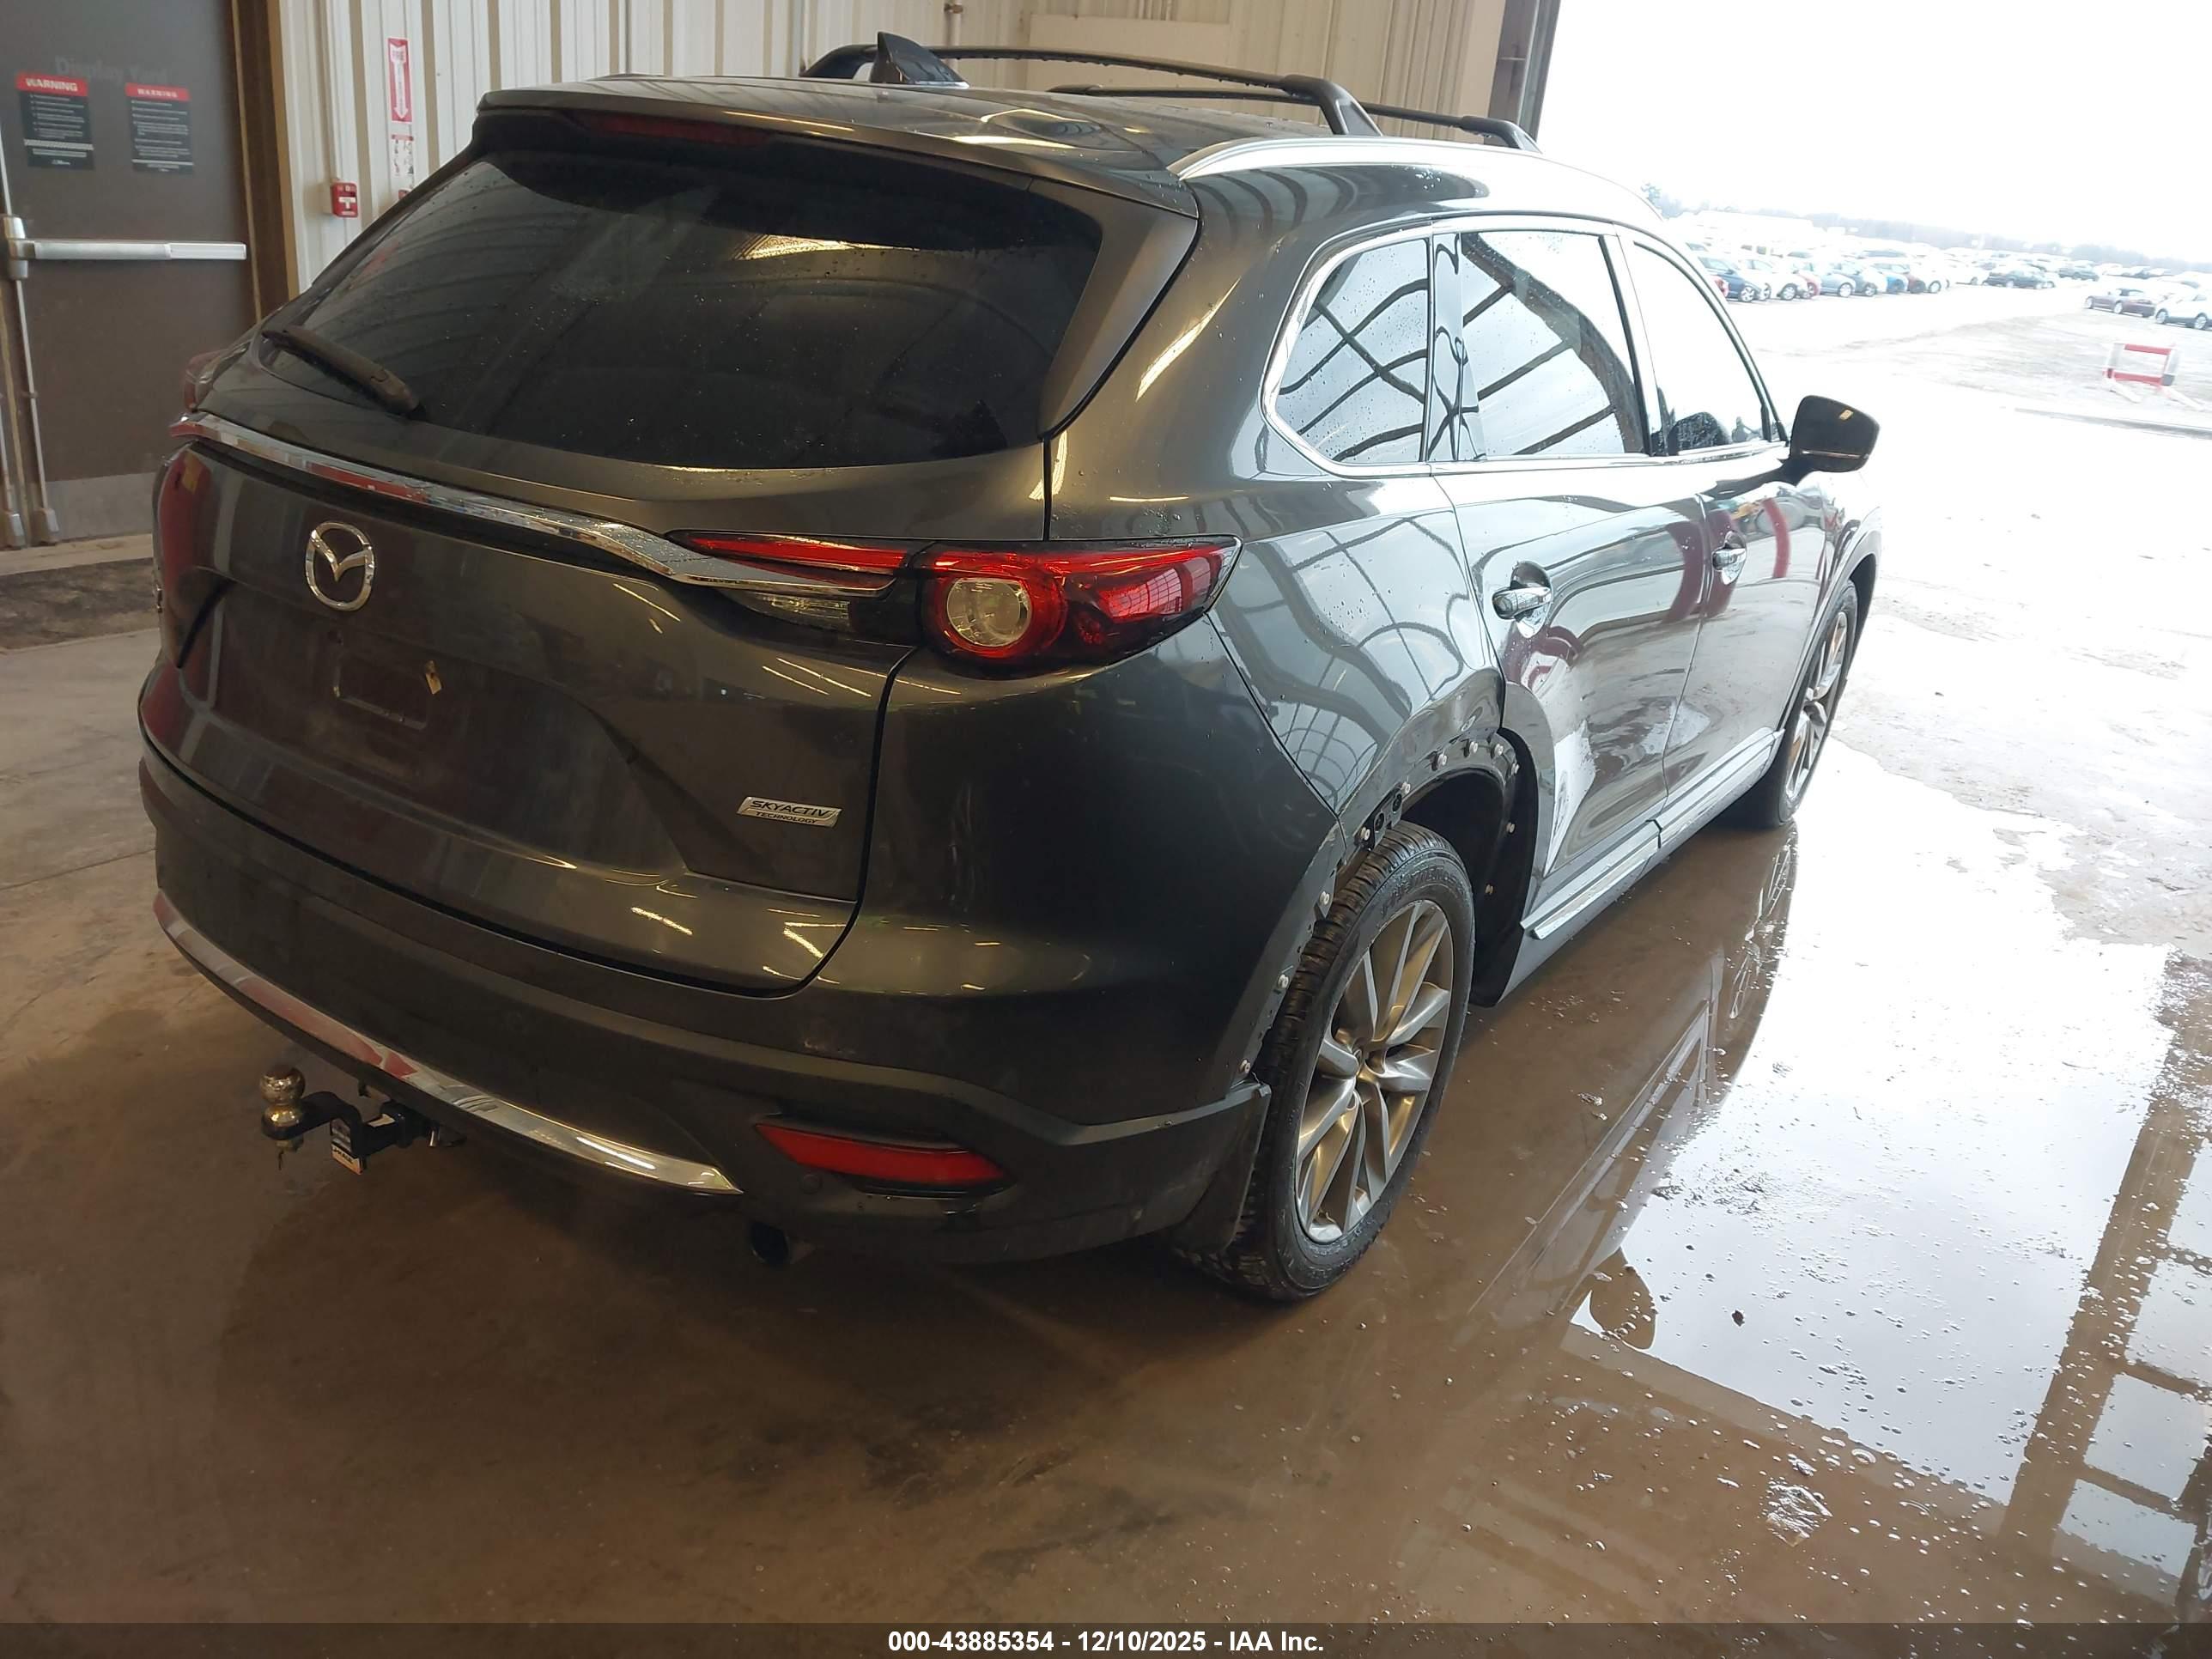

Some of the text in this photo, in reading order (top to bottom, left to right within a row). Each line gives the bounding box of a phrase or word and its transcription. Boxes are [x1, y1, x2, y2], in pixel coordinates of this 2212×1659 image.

[26, 78, 78, 93] WARNING
[750, 800, 830, 817] SKYACTIV
[756, 811, 819, 823] TECHNOLOGY
